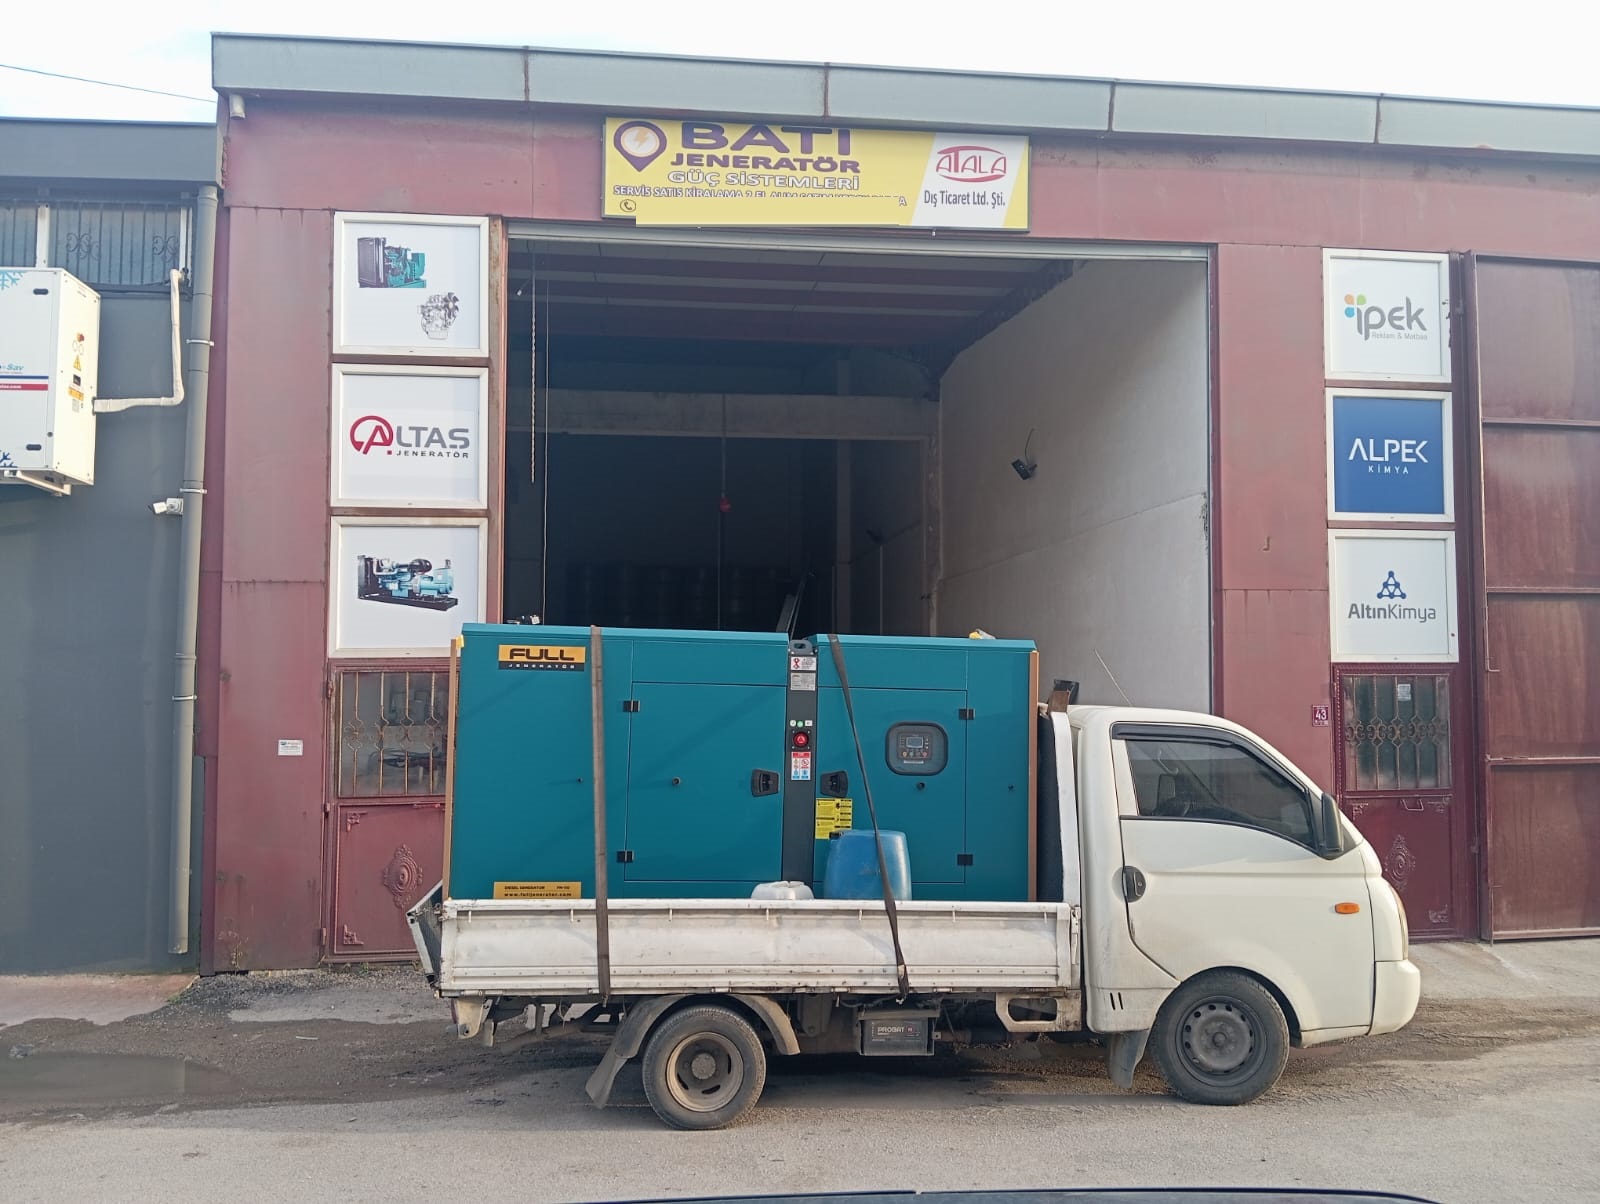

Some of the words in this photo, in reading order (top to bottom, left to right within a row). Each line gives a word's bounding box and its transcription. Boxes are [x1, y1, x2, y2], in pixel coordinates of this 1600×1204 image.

[681, 121, 851, 156] BATI
[671, 153, 861, 173] JENERATÖR
[936, 146, 1007, 174] ATALA
[668, 169, 720, 186] GÜÇ
[725, 171, 860, 190] SİSTEMLERİ
[613, 184, 651, 197] SERVİS
[924, 190, 938, 207] Dış
[940, 190, 970, 205] Ticaret
[973, 191, 989, 206] Ltd.
[991, 192, 1006, 208] Şti.
[1348, 438, 1428, 463] ALPEK
[1368, 464, 1409, 474] KİMYA
[1348, 603, 1436, 623] AltınKimya
[509, 648, 575, 661] FULL
[1315, 709, 1326, 720] 43
